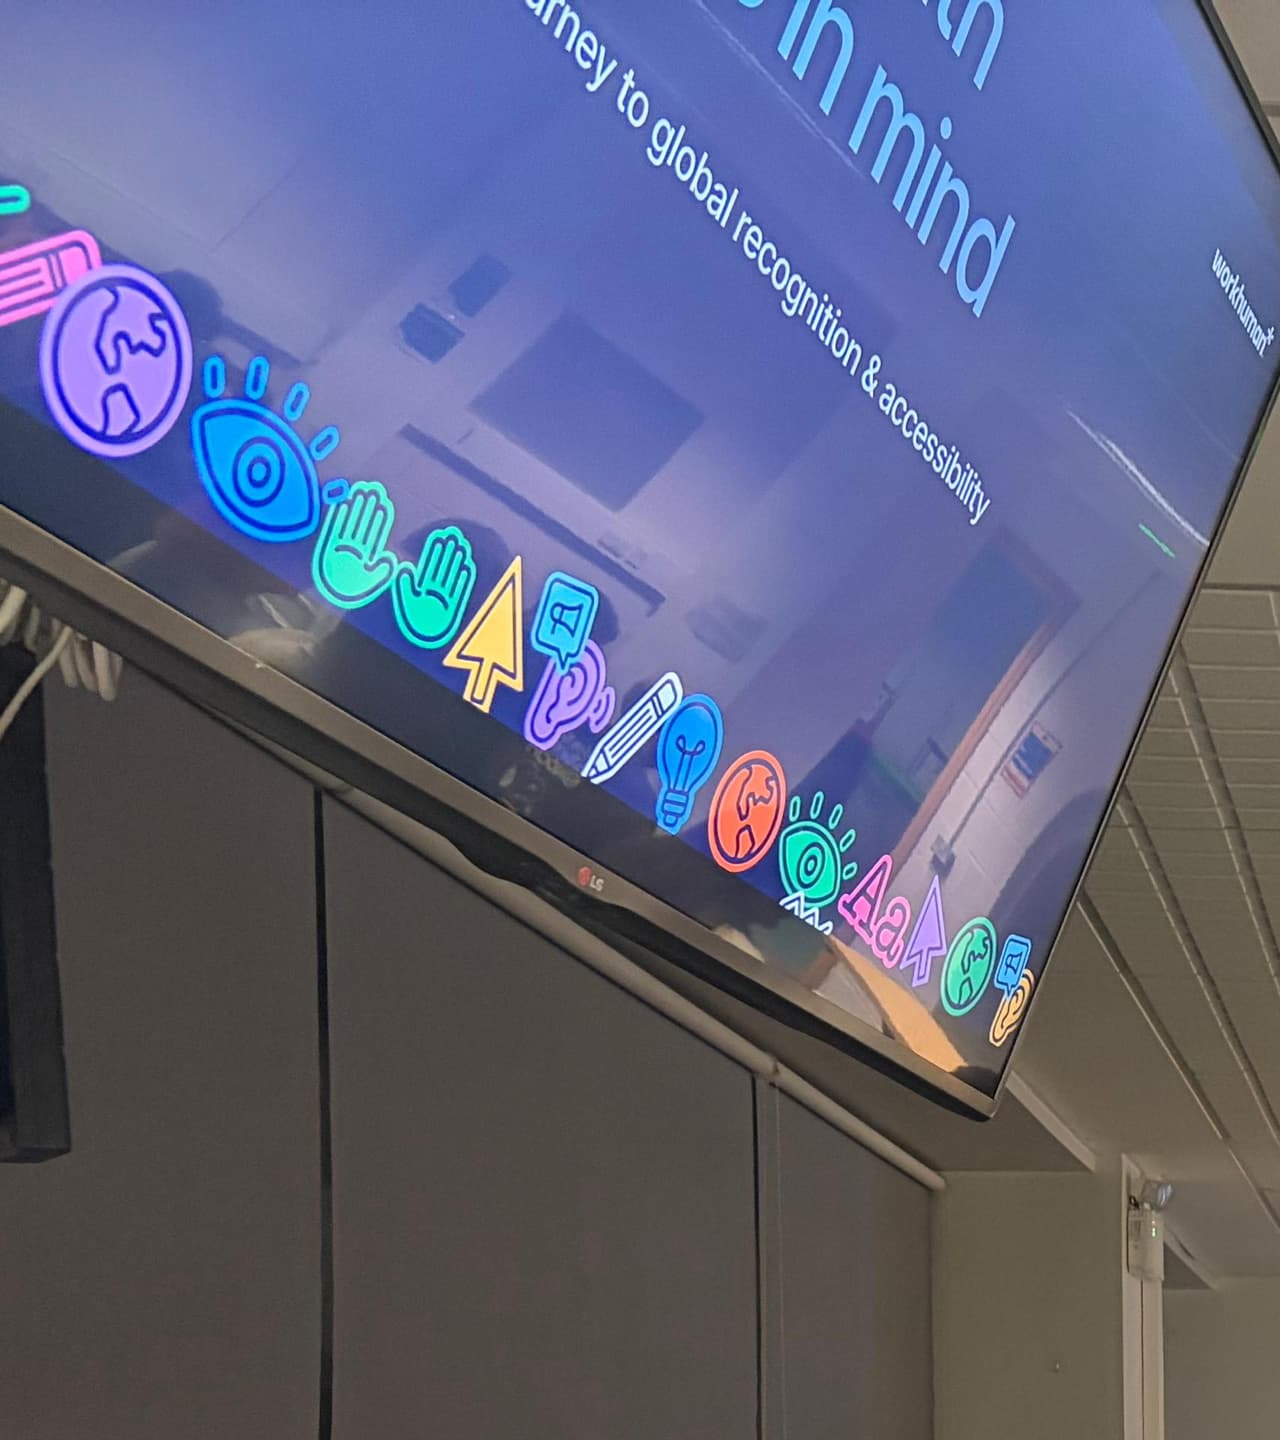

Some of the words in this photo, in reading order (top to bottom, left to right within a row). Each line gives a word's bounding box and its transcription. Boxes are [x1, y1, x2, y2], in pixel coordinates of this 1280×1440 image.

[617, 69, 649, 127] to
[647, 118, 738, 228] global
[732, 211, 863, 377] recognition
[861, 355, 882, 398] &
[878, 383, 991, 526] accessibility
[848, 64, 1016, 318] mind
